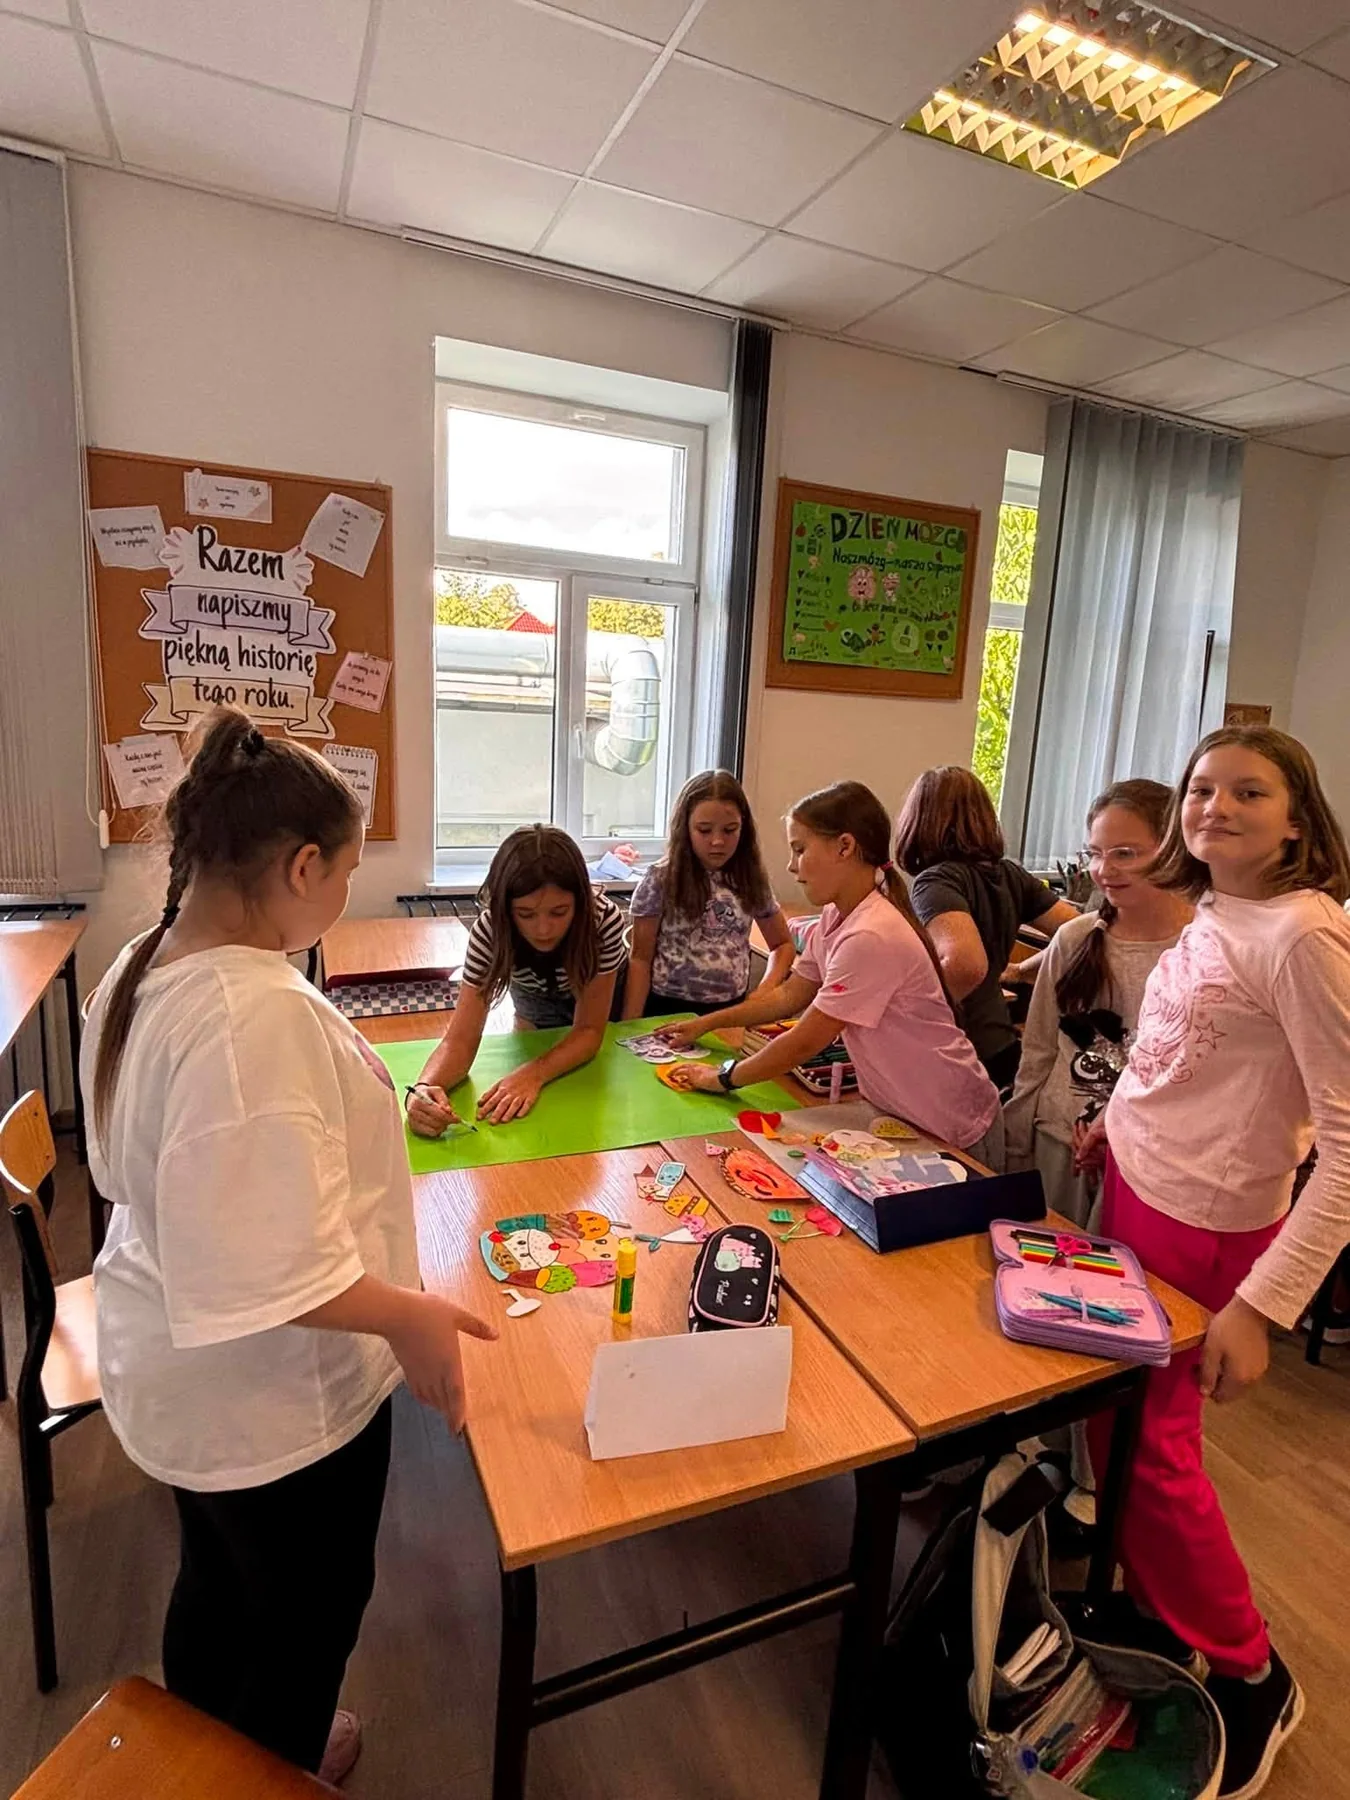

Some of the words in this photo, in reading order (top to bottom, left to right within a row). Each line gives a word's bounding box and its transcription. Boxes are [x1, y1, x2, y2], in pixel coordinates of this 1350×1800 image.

[197, 525, 285, 580] Razem
[197, 592, 292, 634] napiszmy
[164, 630, 231, 675] piękną
[238, 636, 314, 677] historię
[245, 677, 294, 709] roku.
